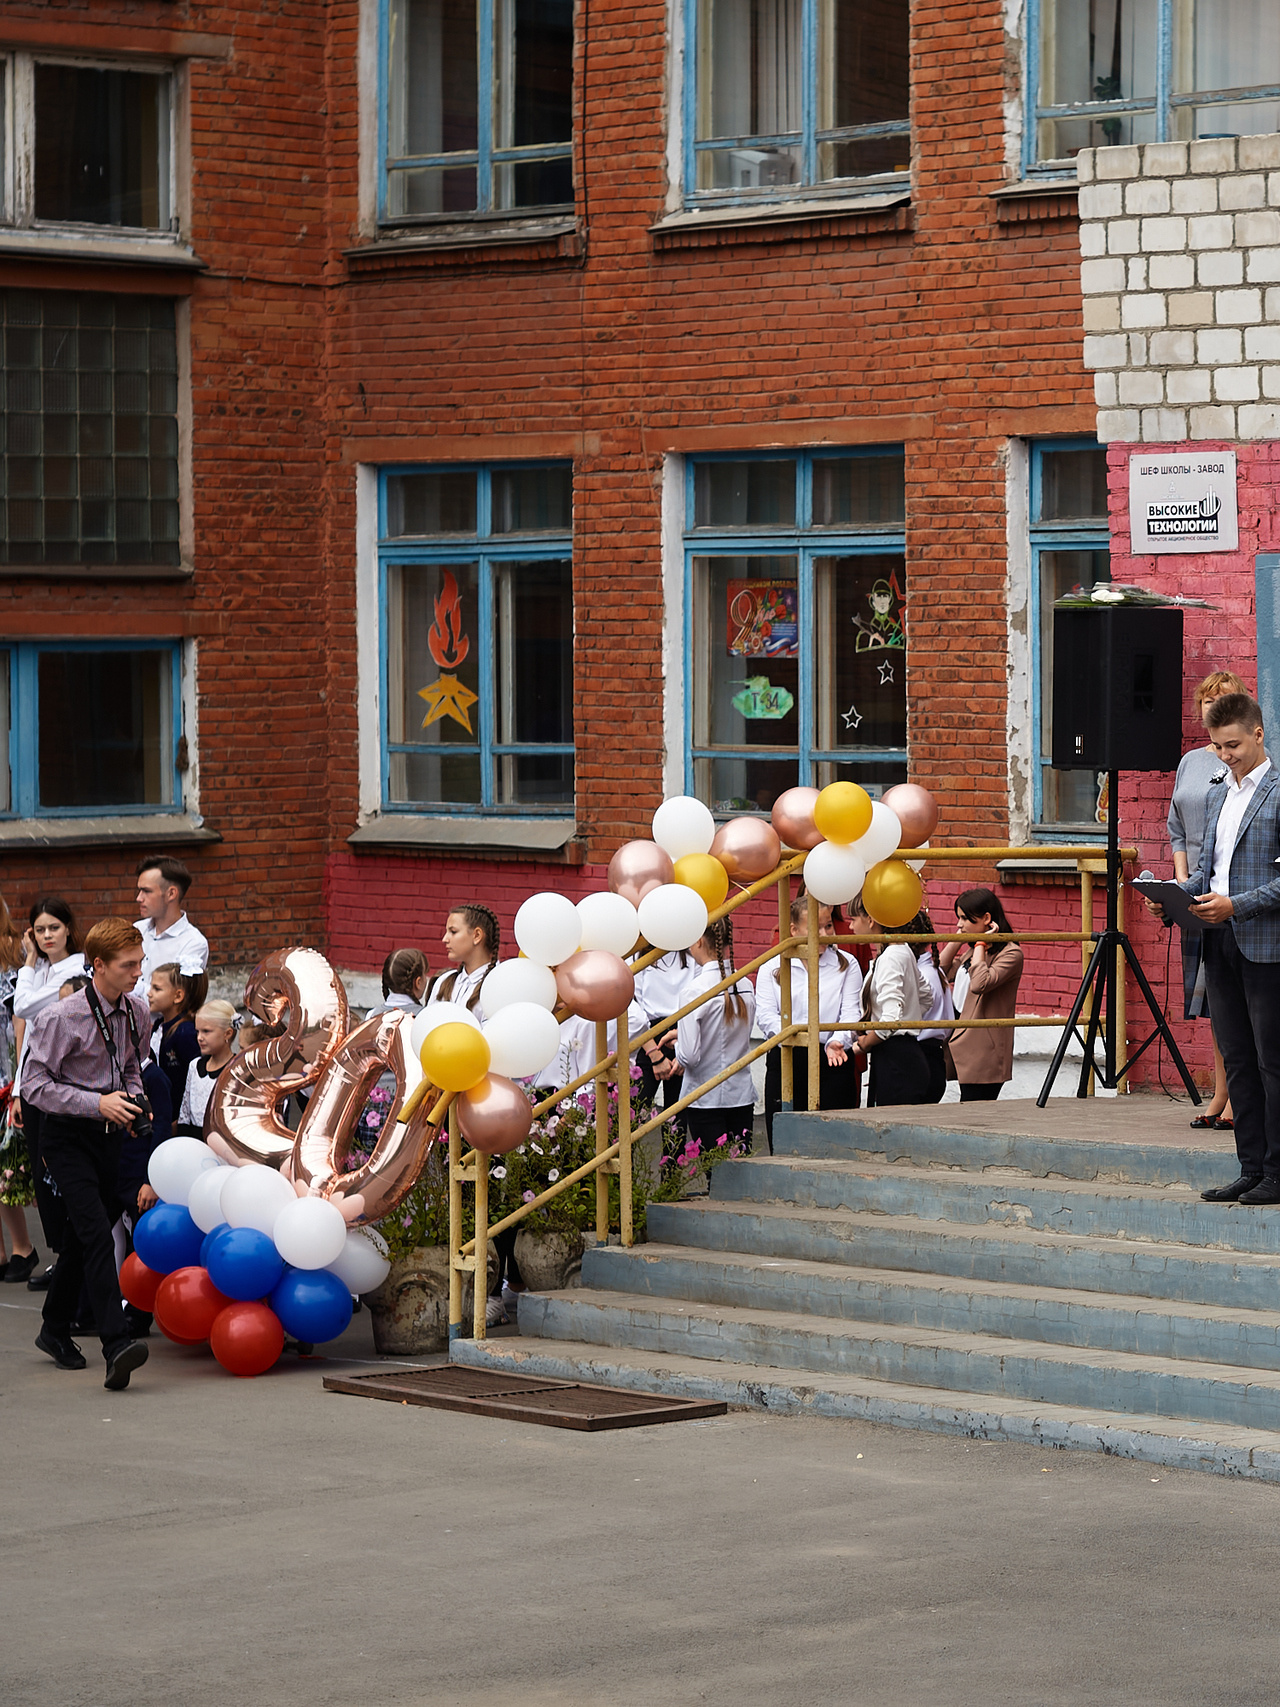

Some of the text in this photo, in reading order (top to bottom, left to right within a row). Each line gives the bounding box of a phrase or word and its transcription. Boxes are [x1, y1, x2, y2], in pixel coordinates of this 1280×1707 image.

[1140, 467, 1159, 475] ШЕФ
[1161, 465, 1191, 474] ШКОЛЫ
[1197, 464, 1225, 473] ЗАВОД
[1149, 504, 1198, 516] ВЫСОКИЕ
[1148, 519, 1217, 533] ТЕХНОЛОГИИ
